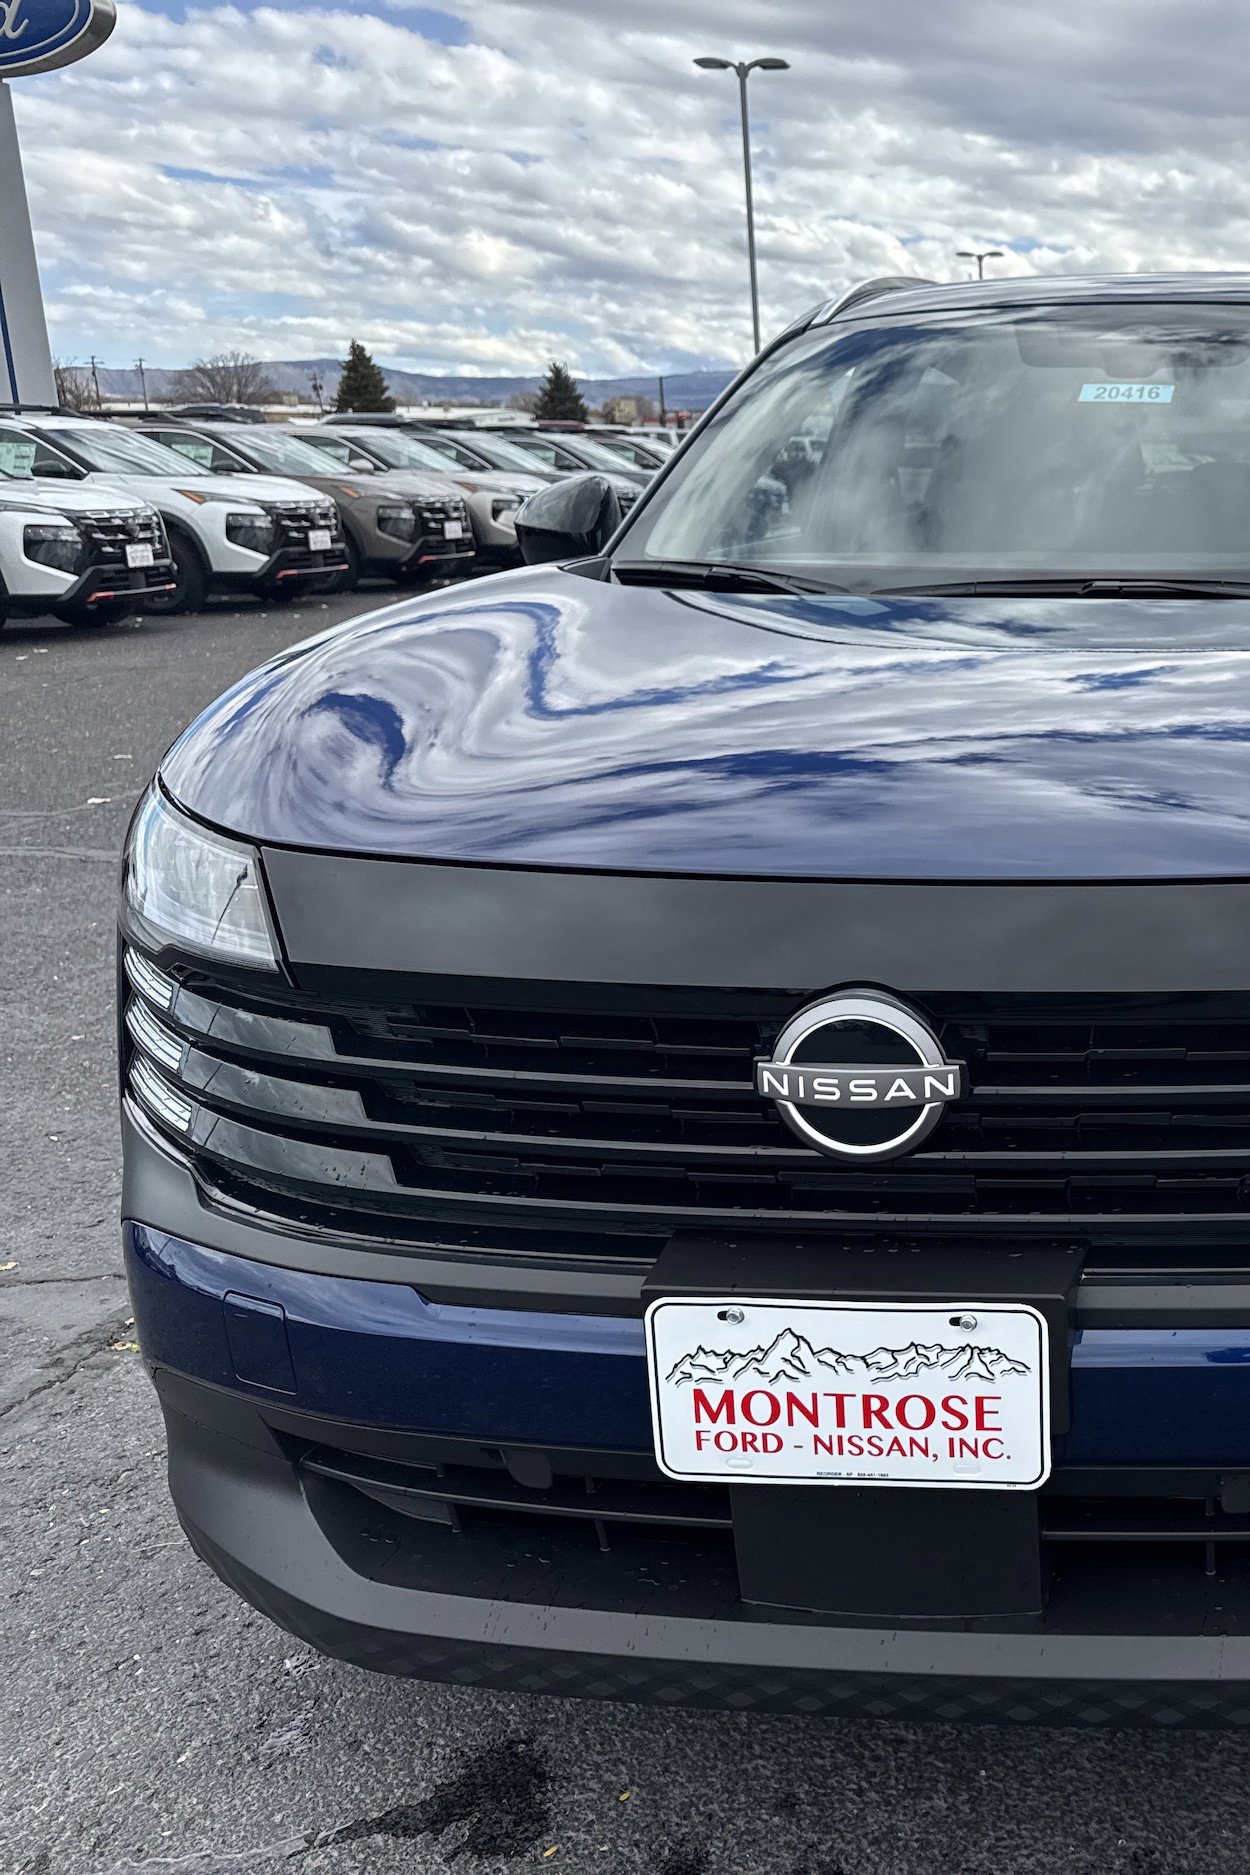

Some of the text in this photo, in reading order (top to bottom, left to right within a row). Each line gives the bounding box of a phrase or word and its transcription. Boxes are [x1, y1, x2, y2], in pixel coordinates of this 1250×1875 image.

[1093, 386, 1161, 400] 20416
[762, 1070, 955, 1101] NISSAN
[693, 1388, 1003, 1432] MONTROSE
[695, 1430, 784, 1453] FORD
[813, 1434, 938, 1462] NISSAN,
[948, 1437, 1012, 1460] INC.
